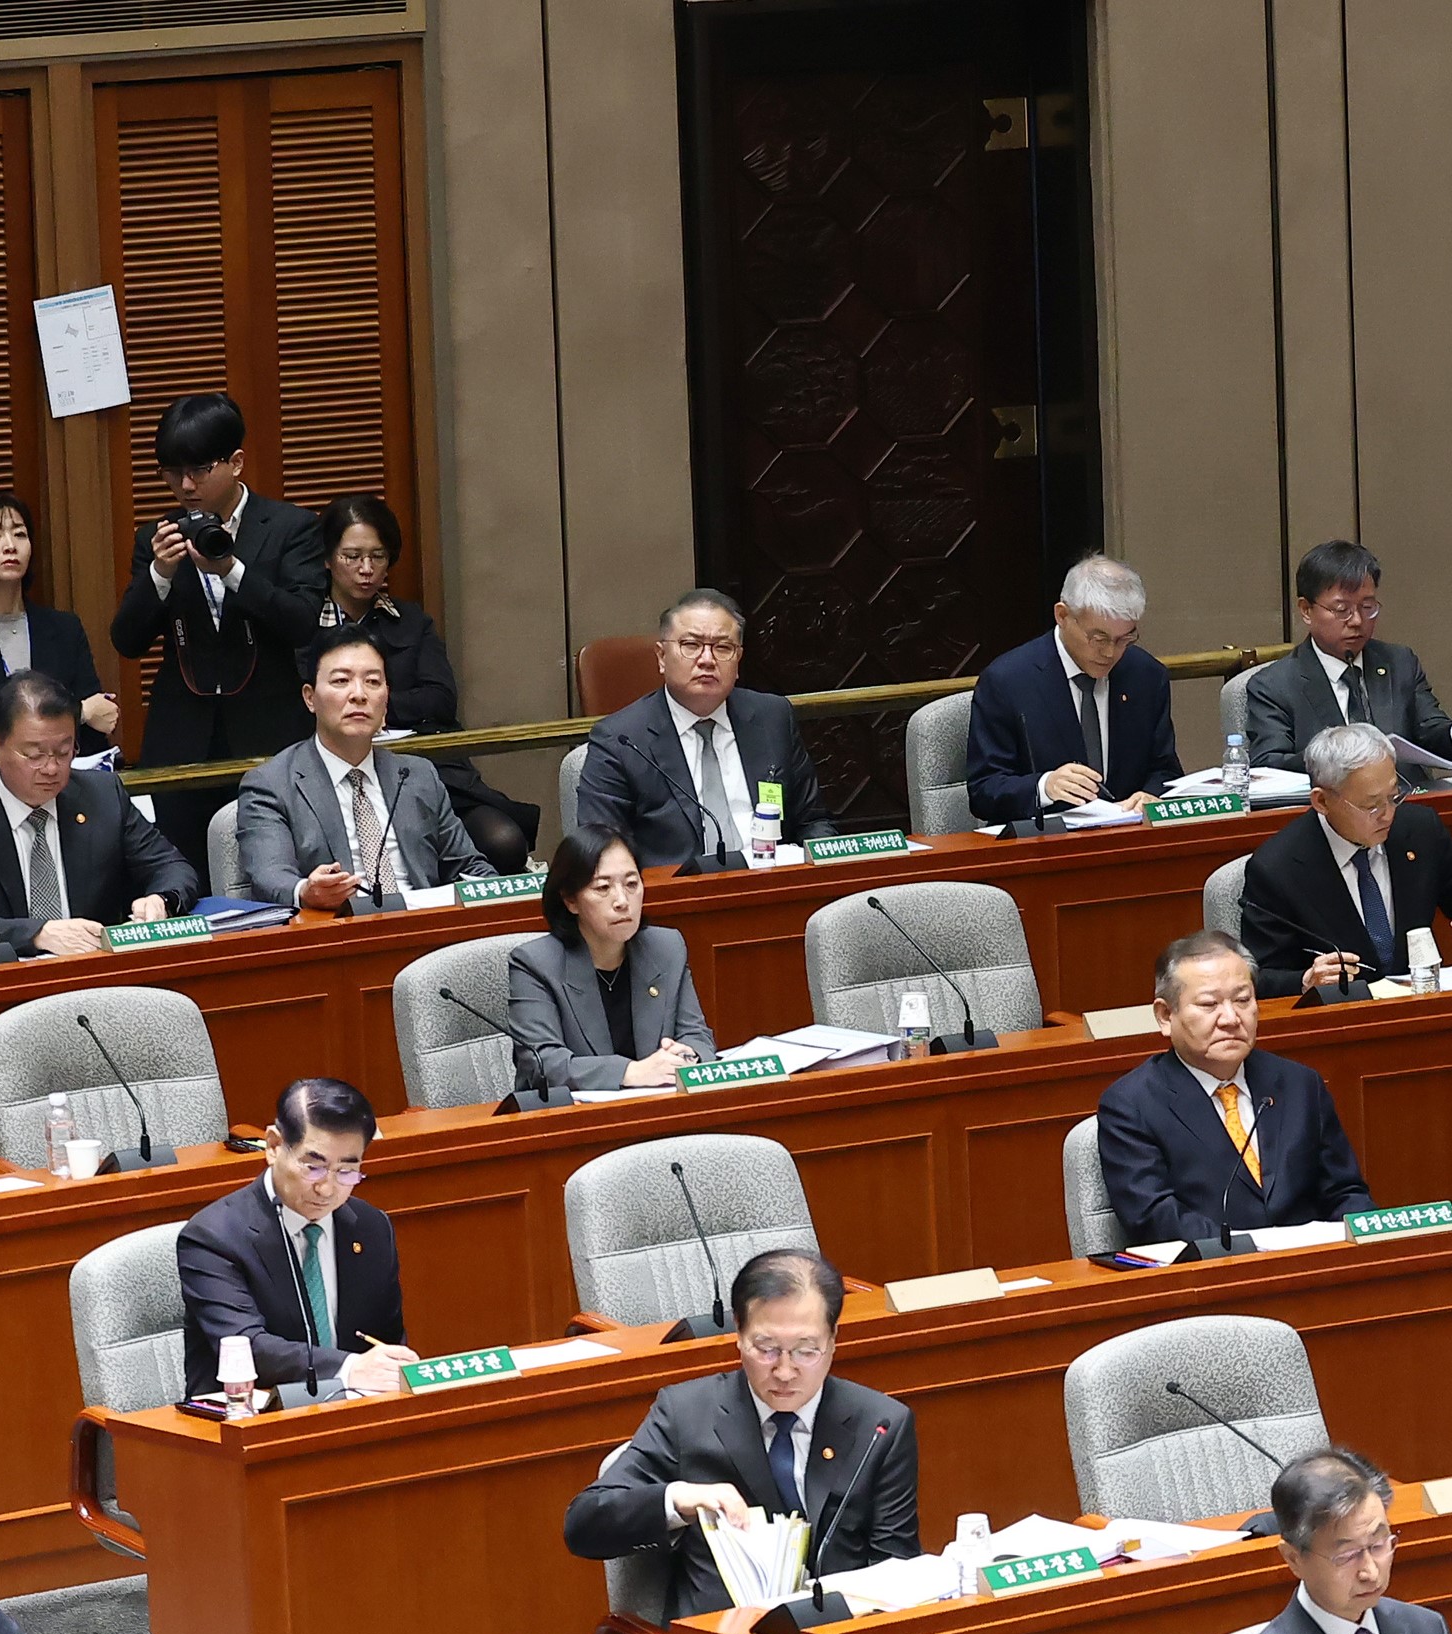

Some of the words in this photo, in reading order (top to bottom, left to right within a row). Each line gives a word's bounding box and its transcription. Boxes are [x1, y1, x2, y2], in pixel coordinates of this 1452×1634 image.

[1155, 797, 1233, 818] 법원행정처장
[688, 1060, 778, 1083] 여성가족부장관
[1353, 1205, 1452, 1232] 행정안전부장관
[417, 1353, 502, 1381] 국방부장관
[997, 1552, 1085, 1584] 법무부장관
